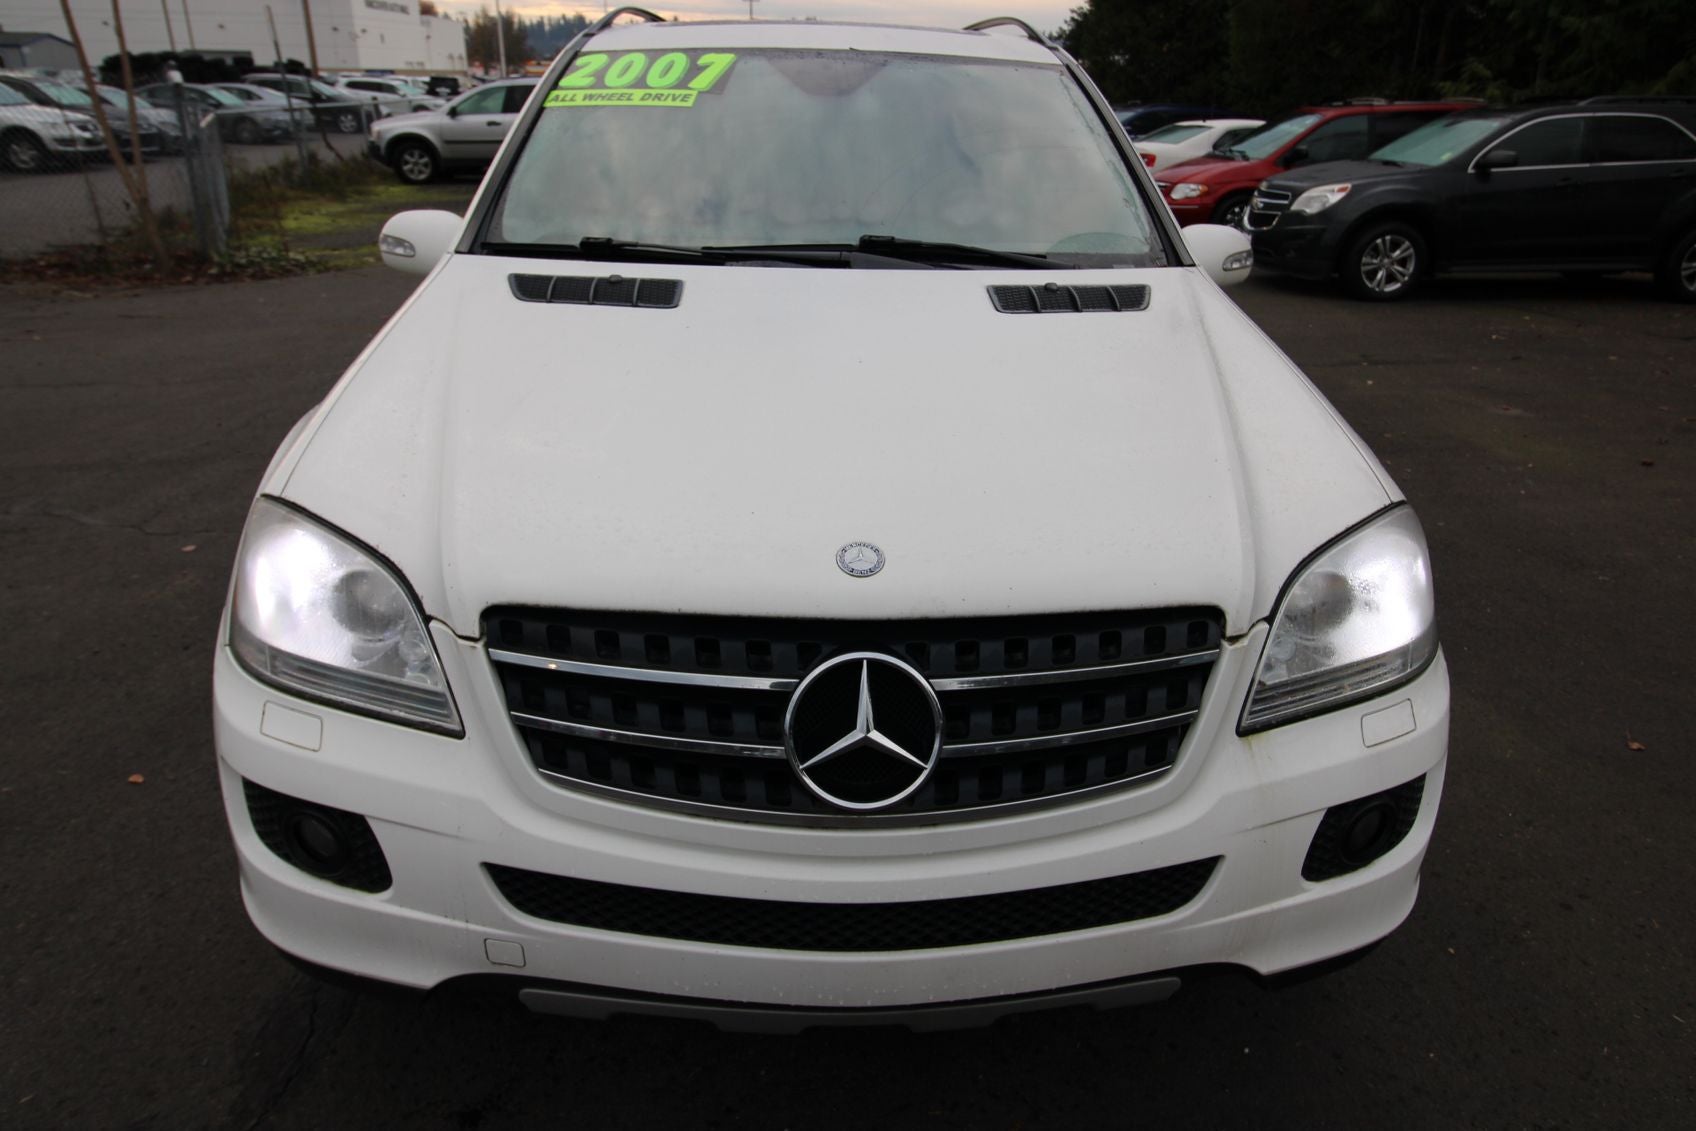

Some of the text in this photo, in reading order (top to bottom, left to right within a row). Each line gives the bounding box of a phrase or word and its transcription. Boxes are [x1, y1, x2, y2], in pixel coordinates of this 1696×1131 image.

[559, 52, 737, 91] 2007
[551, 92, 693, 103] ALL WHEEL DRIVE
